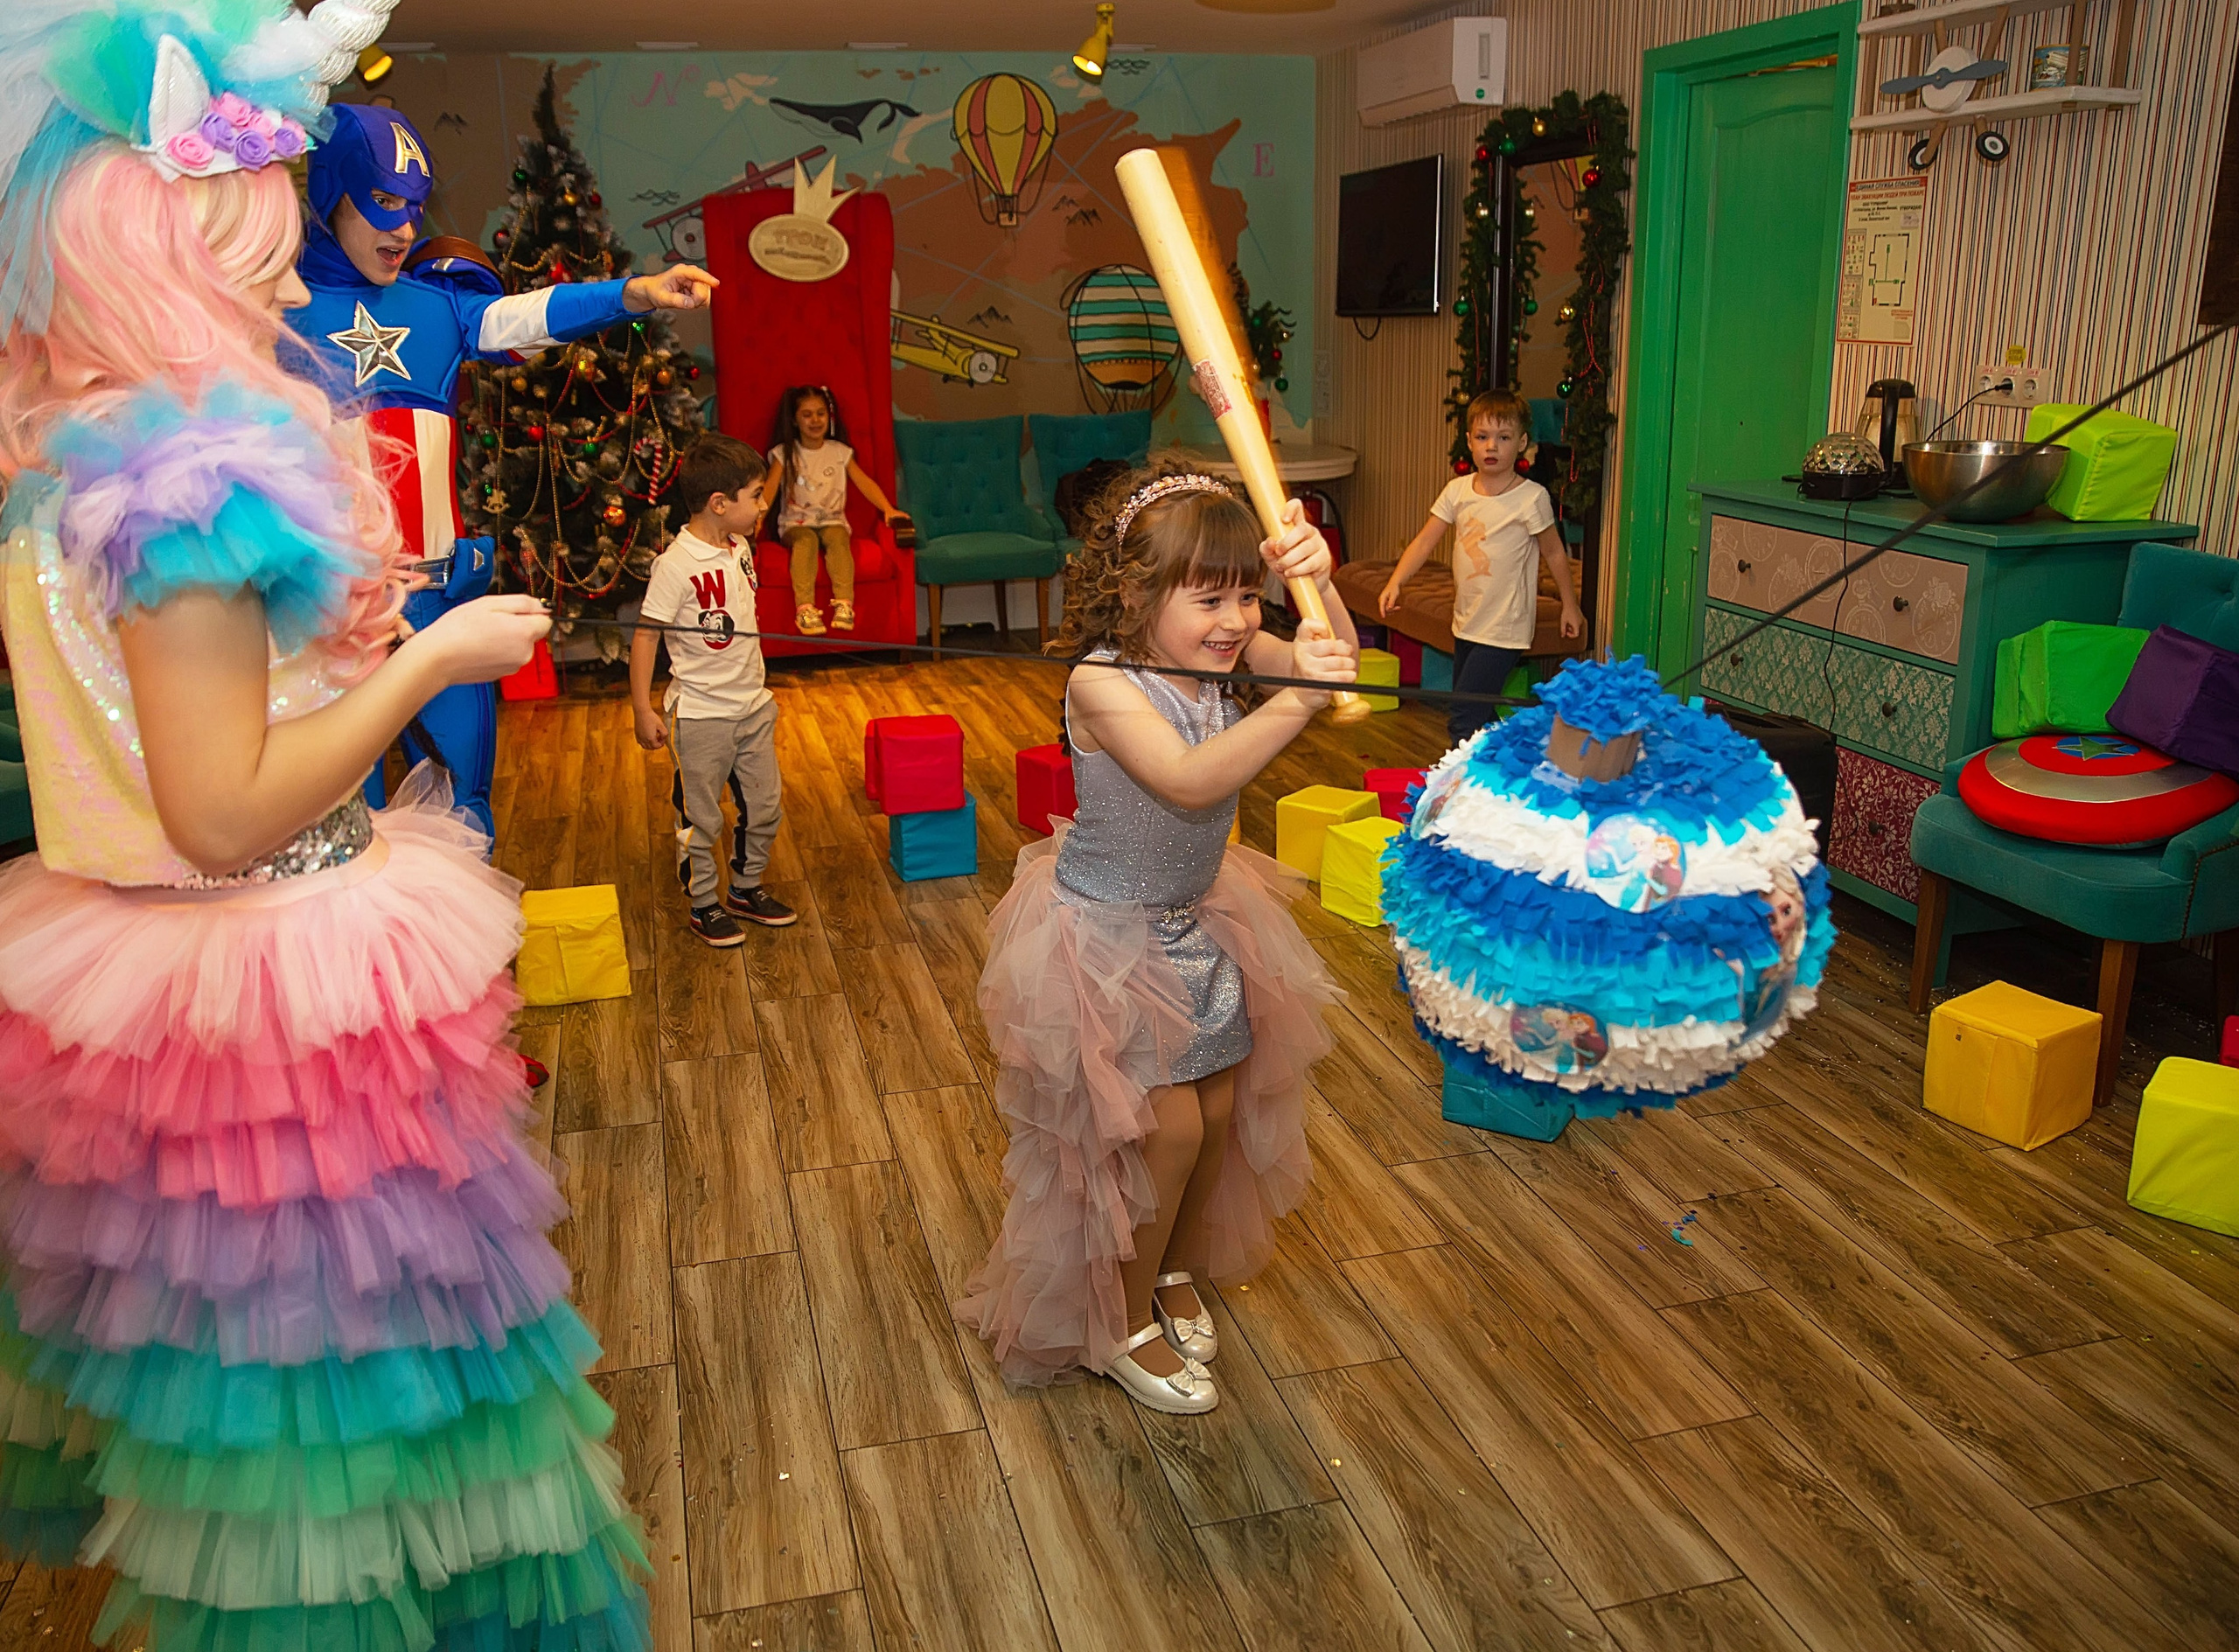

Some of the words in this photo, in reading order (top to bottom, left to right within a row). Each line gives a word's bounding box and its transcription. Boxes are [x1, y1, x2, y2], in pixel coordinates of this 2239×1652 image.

[389, 122, 430, 178] A
[1253, 142, 1275, 177] E
[689, 568, 726, 610] W
